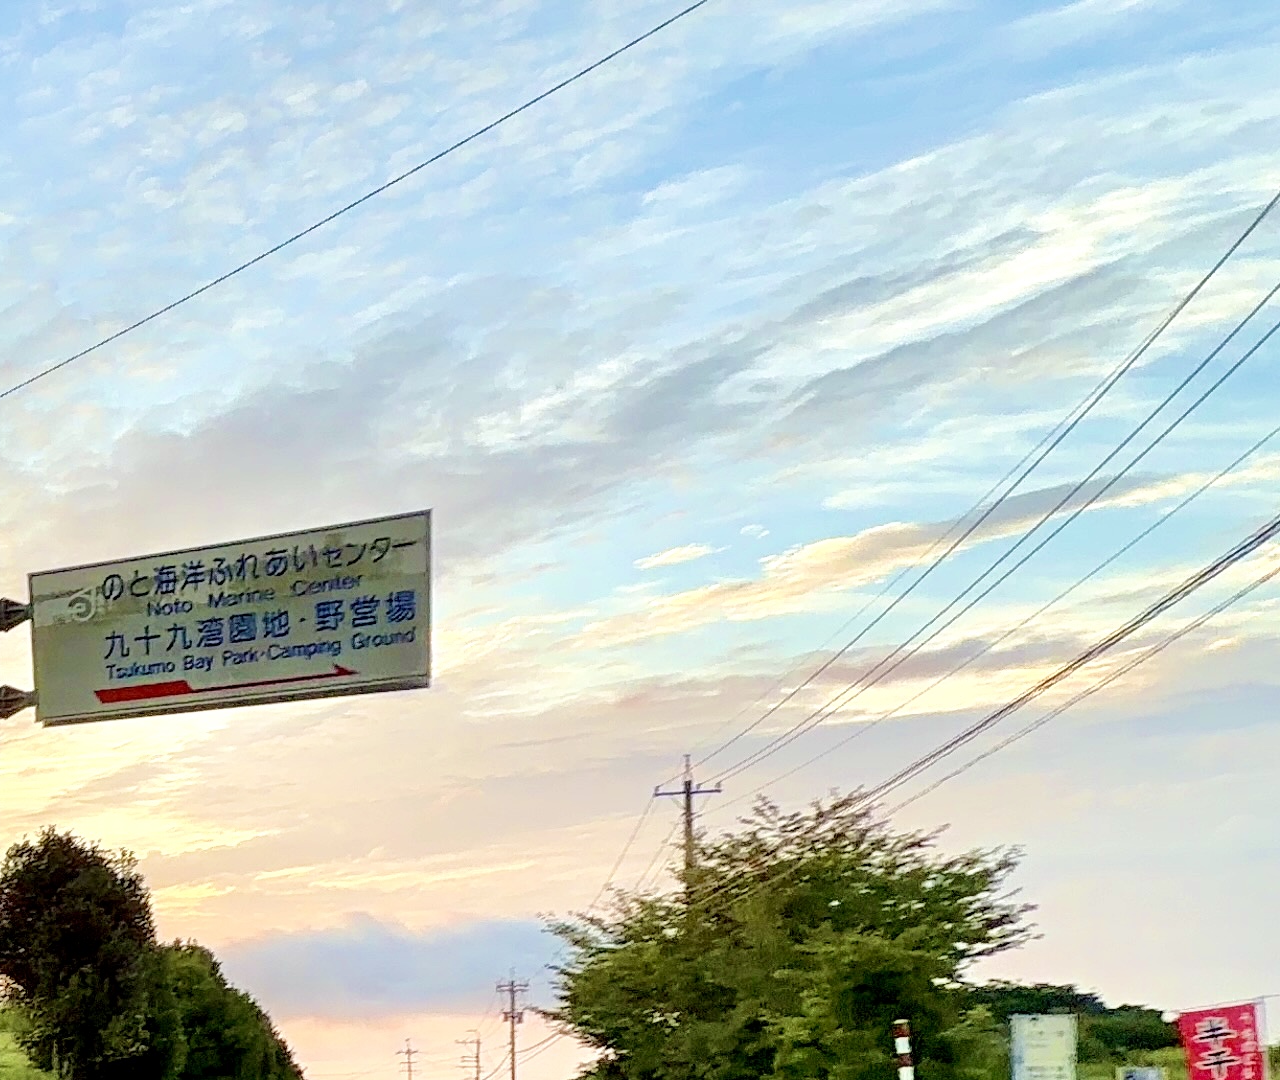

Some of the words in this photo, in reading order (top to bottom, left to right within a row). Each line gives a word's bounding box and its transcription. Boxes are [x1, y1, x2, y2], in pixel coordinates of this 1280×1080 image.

[102, 536, 417, 602] のと海洋ふれあいセンター
[147, 598, 193, 617] Noto
[208, 588, 275, 608] Marine
[291, 574, 364, 597] Center
[105, 660, 176, 680] Tsukumo
[183, 654, 214, 672] Bay
[351, 626, 417, 650] Ground
